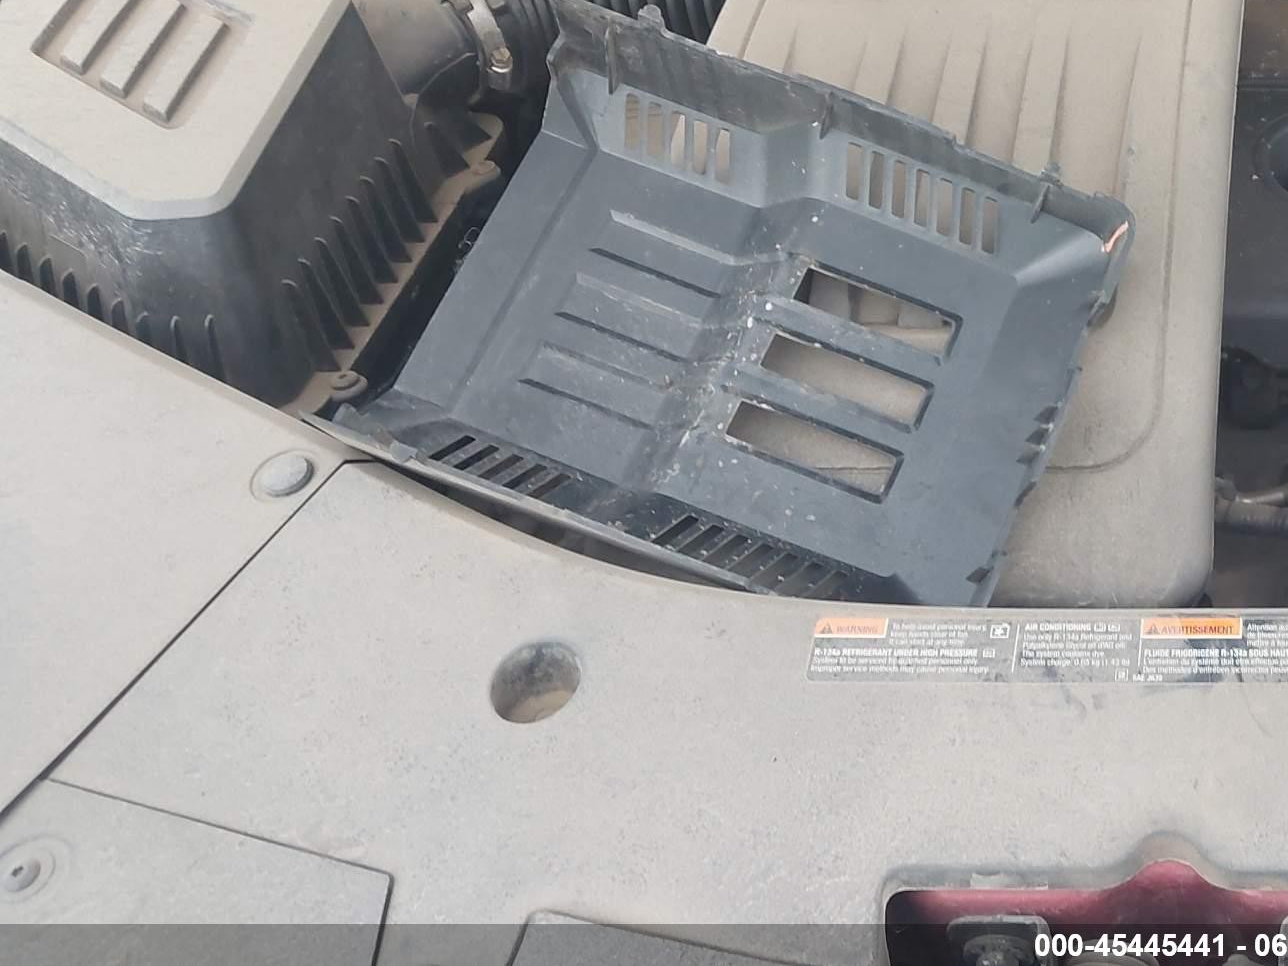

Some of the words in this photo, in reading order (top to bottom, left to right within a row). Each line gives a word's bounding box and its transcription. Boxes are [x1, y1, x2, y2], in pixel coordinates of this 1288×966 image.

[837, 626, 878, 634] WARNING
[1025, 623, 1038, 631] AIR
[1040, 623, 1091, 631] CONDITIONING
[1161, 625, 1233, 634] AVERTISSEMENT
[842, 648, 892, 656] REFRIGERANT
[894, 648, 918, 656] UNDER
[920, 648, 938, 656] HIGH
[940, 648, 977, 656] PRESSURE
[1144, 649, 1169, 657] FLUIDE
[1249, 649, 1269, 657] SOUS
